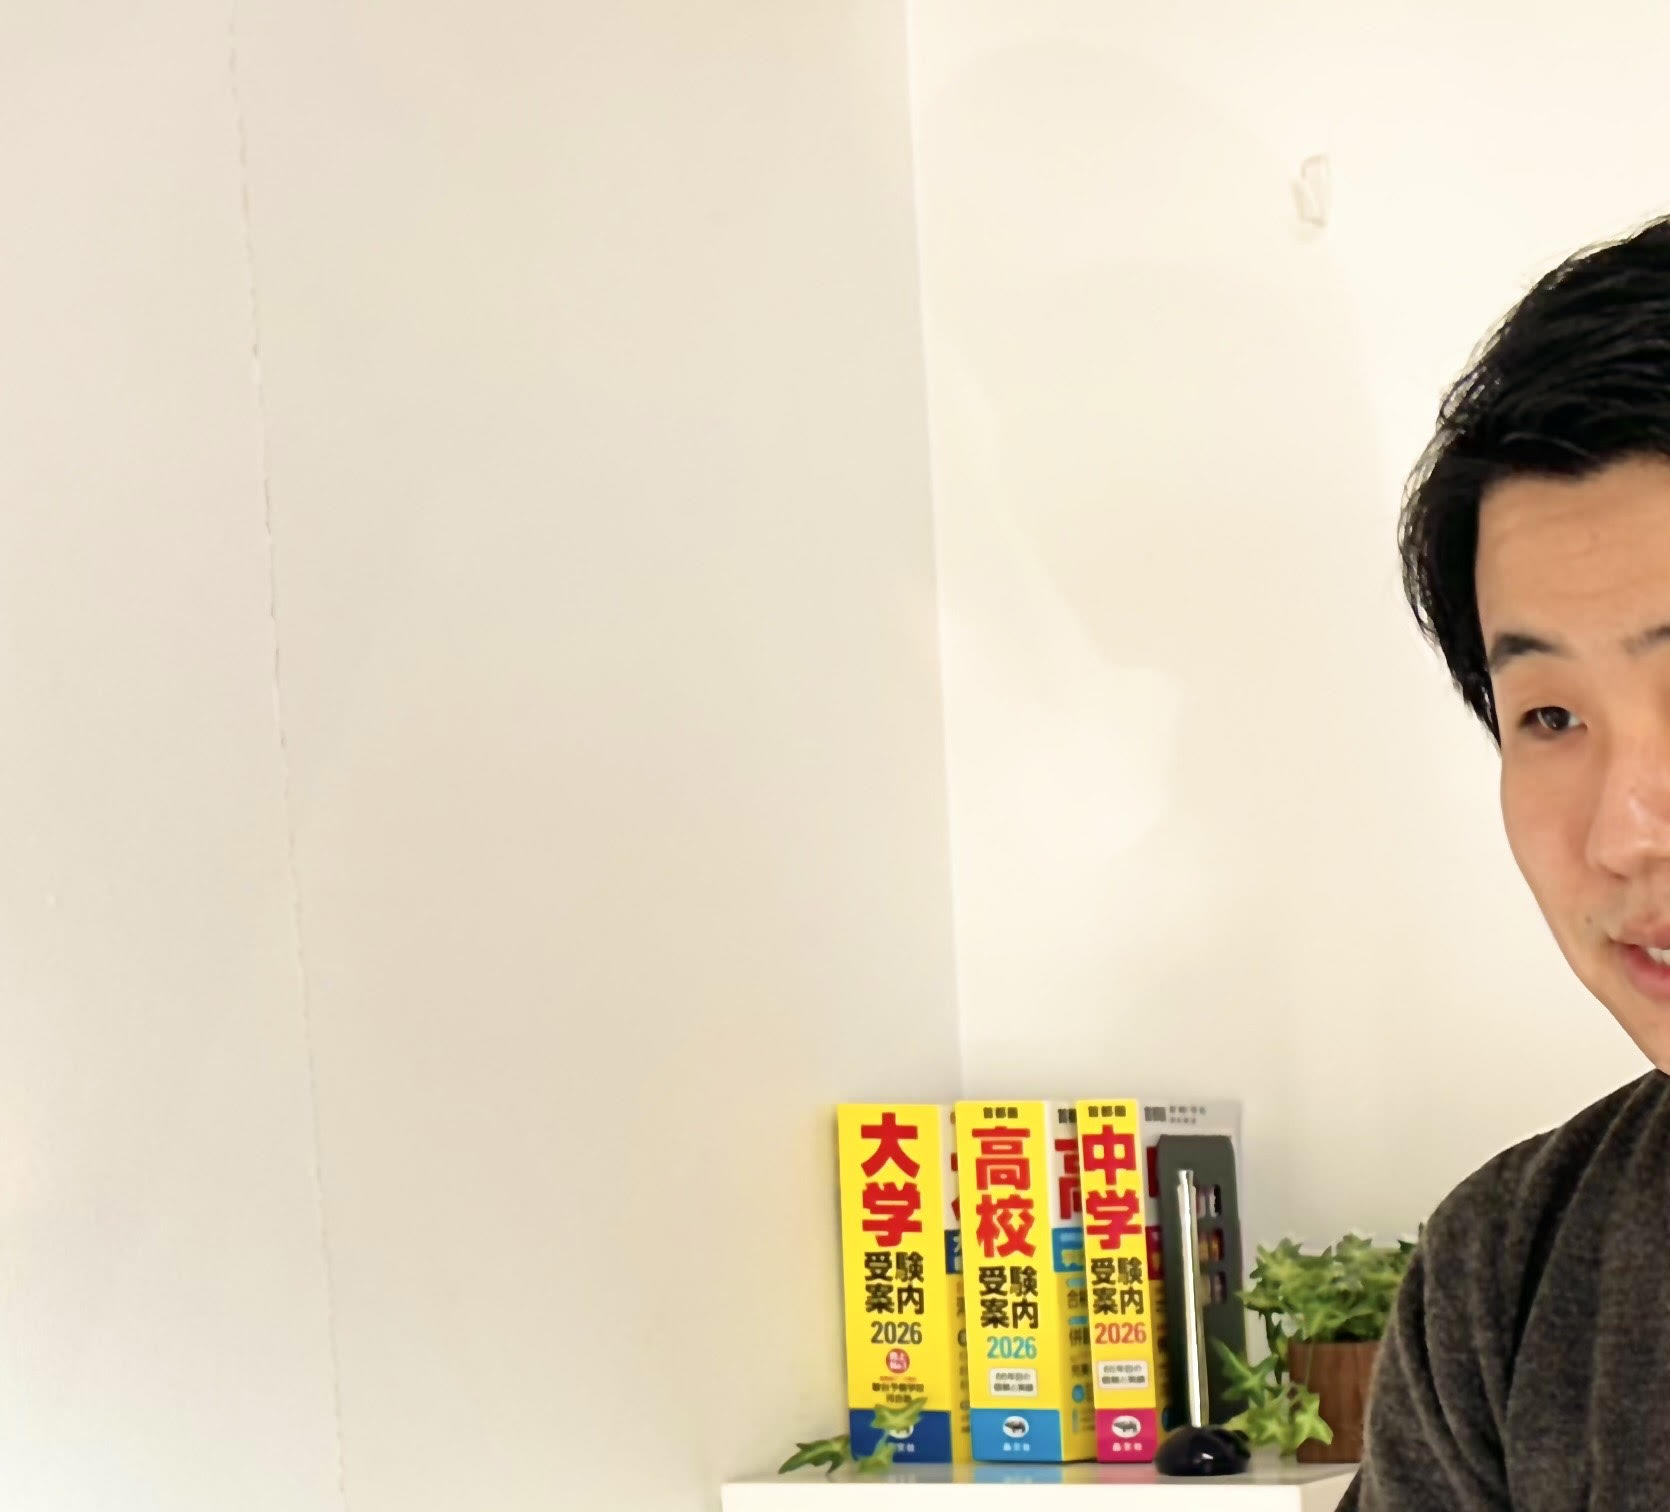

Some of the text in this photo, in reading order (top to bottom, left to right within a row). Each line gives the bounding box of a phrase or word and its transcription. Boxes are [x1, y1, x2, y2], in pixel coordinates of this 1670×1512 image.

[861, 1111, 922, 1247] 大学
[971, 1126, 1037, 1258] 高校
[1082, 1124, 1142, 1250] 中学
[864, 1251, 925, 1283] 受験
[978, 1265, 1039, 1297] 受験
[1090, 1257, 1144, 1286] 受験
[865, 1283, 925, 1315] 案内
[980, 1297, 1039, 1329] 案内
[1092, 1286, 1145, 1316] 案内
[870, 1320, 923, 1345] 2026
[986, 1335, 1038, 1360] 2026
[1094, 1322, 1147, 1345] 2026
